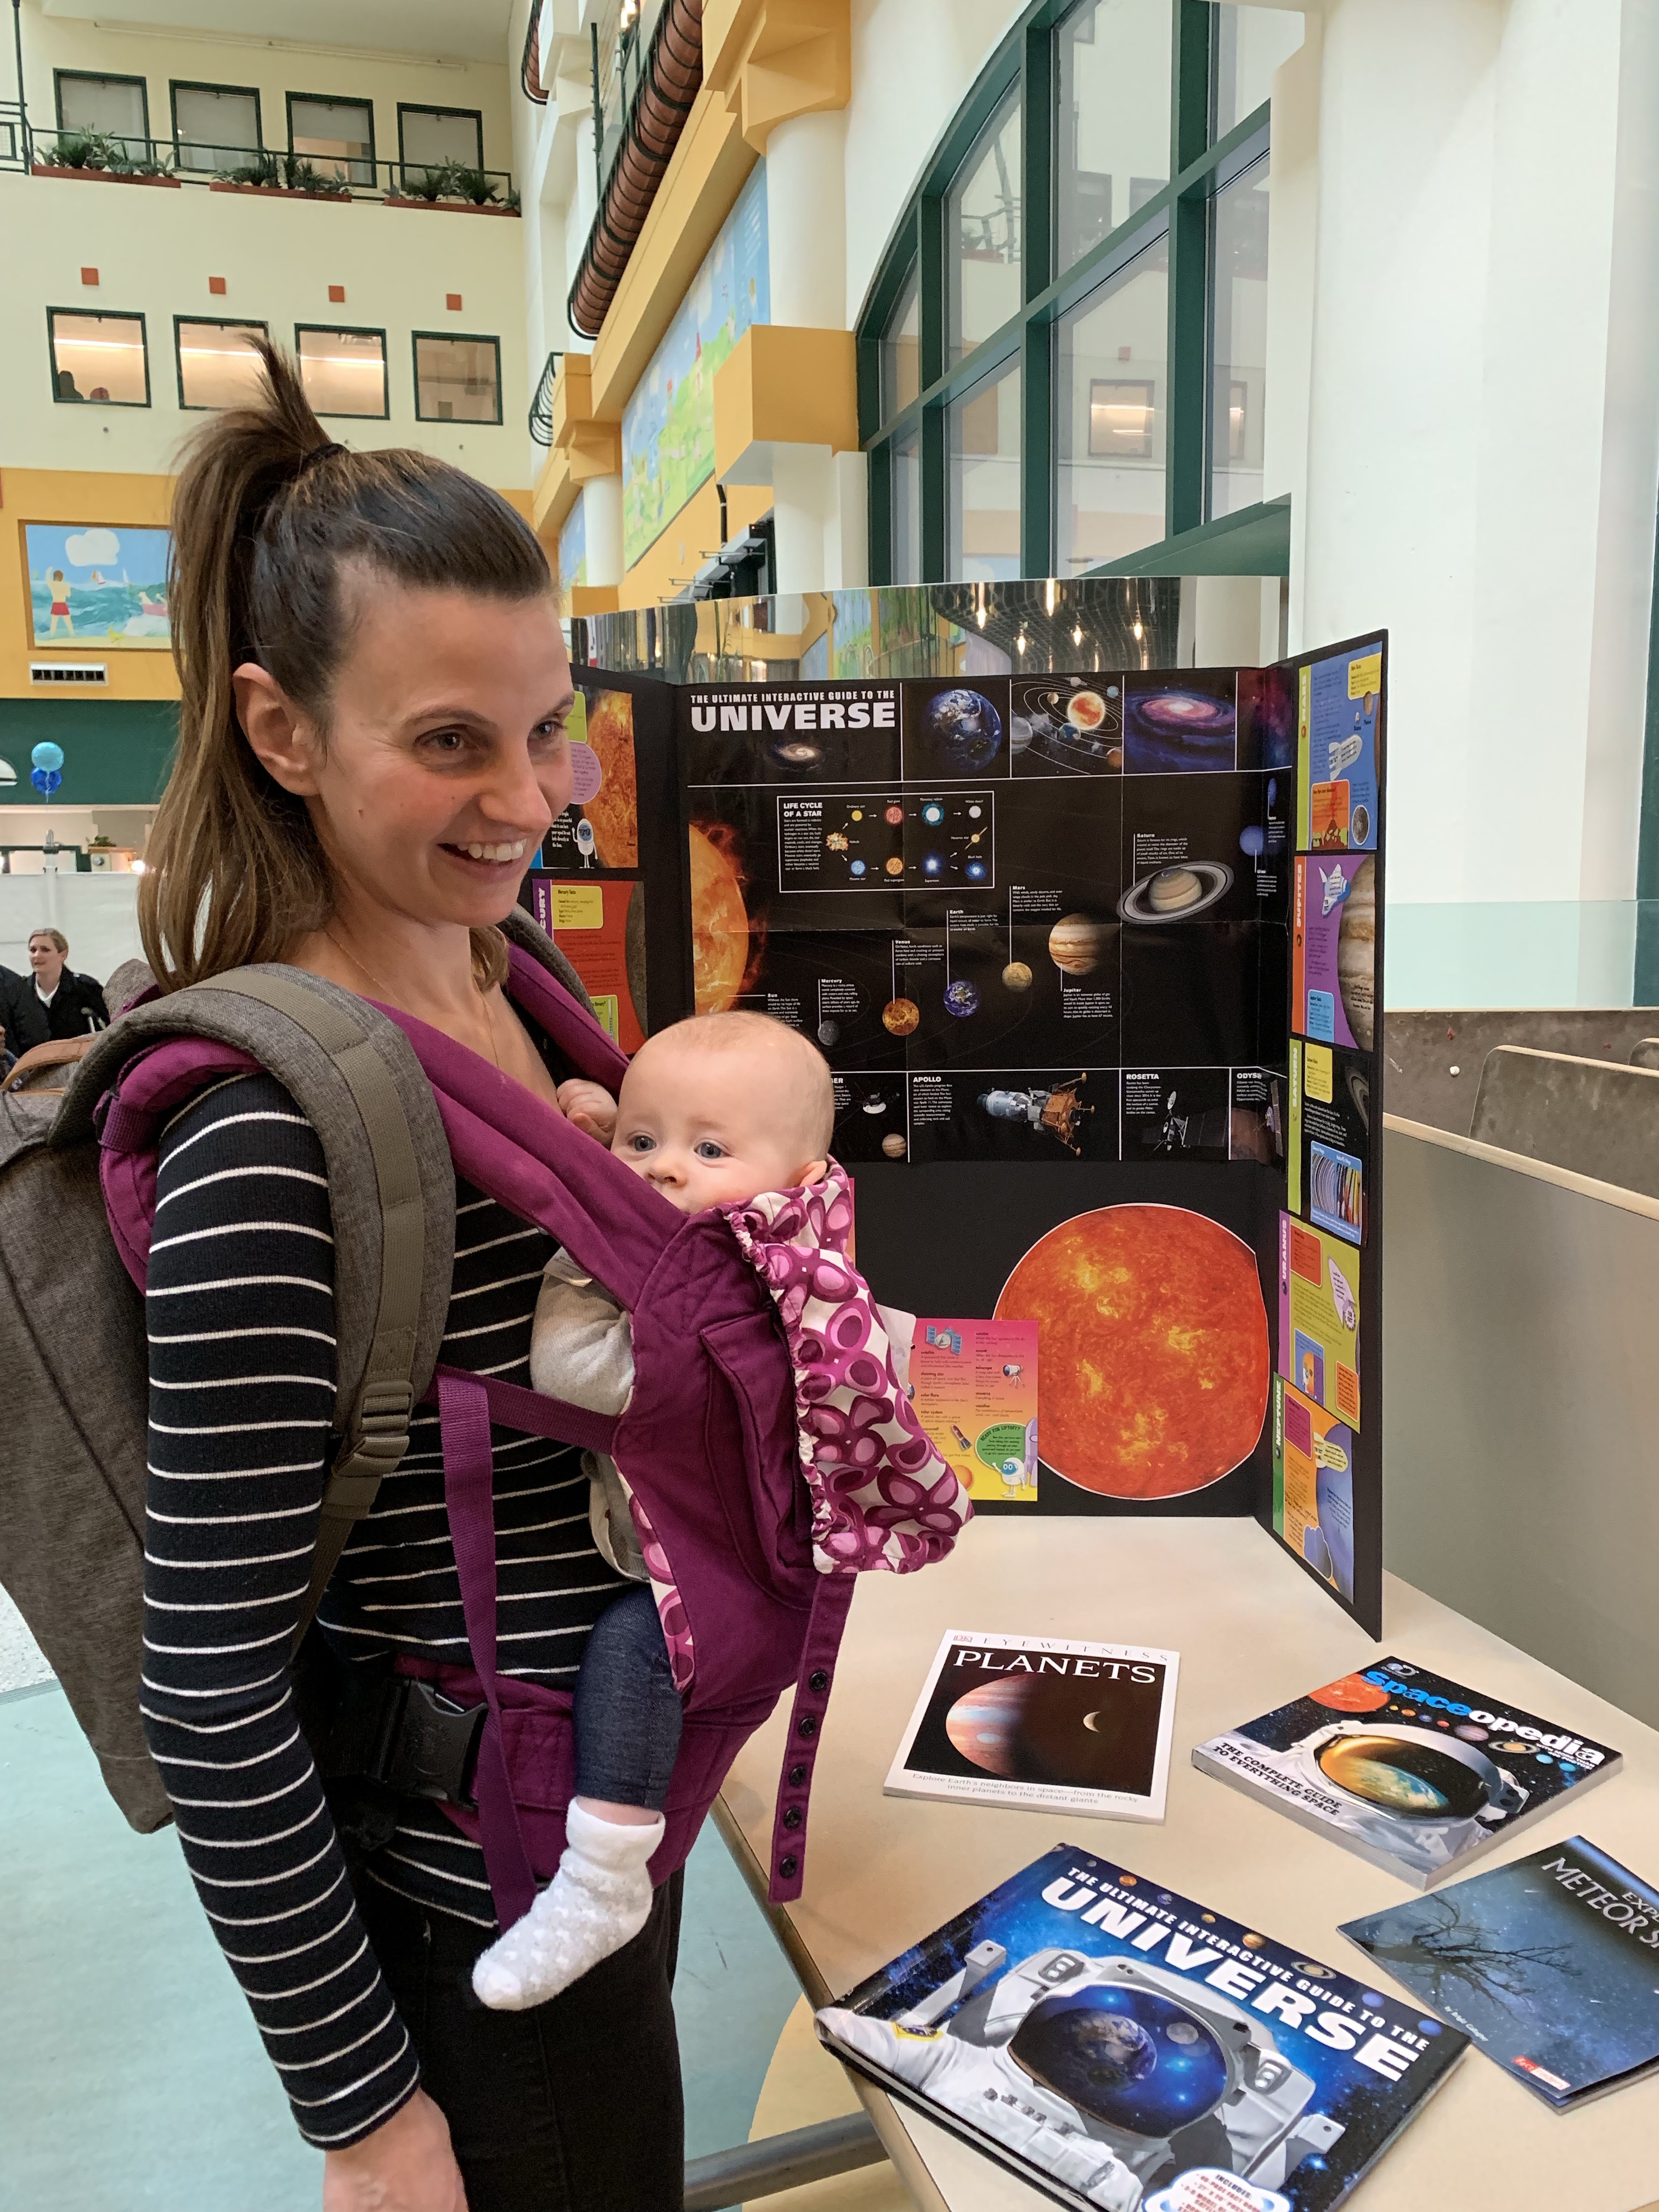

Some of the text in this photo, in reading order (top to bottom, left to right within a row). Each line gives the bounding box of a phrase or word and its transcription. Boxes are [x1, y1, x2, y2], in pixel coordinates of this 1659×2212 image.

[691, 690, 895, 703] THE ULTIMATE INTERACTIVE GUIDE TO THE
[691, 702, 895, 732] UNIVERSE
[953, 1649, 1156, 1684] PLANETS
[1361, 1671, 1606, 1765] Spaceopedia
[912, 1773, 946, 1783] Explore
[948, 1778, 978, 1786] Earth's
[980, 1781, 1025, 1792] neighbors
[1114, 1794, 1138, 1803] rocky
[972, 1786, 1006, 1796] planets
[1036, 1792, 1068, 1802] distant
[1213, 1746, 1340, 1816] TO EVERYTHING SPACE
[1221, 1742, 1343, 1809] THE COMPLETE GUIDE
[1541, 1857, 1649, 1935] METEOR
[1041, 1876, 1420, 2083] UNIVERSE
[1068, 1866, 1431, 2051] THE ULTIMATE INTERACTIVE GUIDE TO THE
